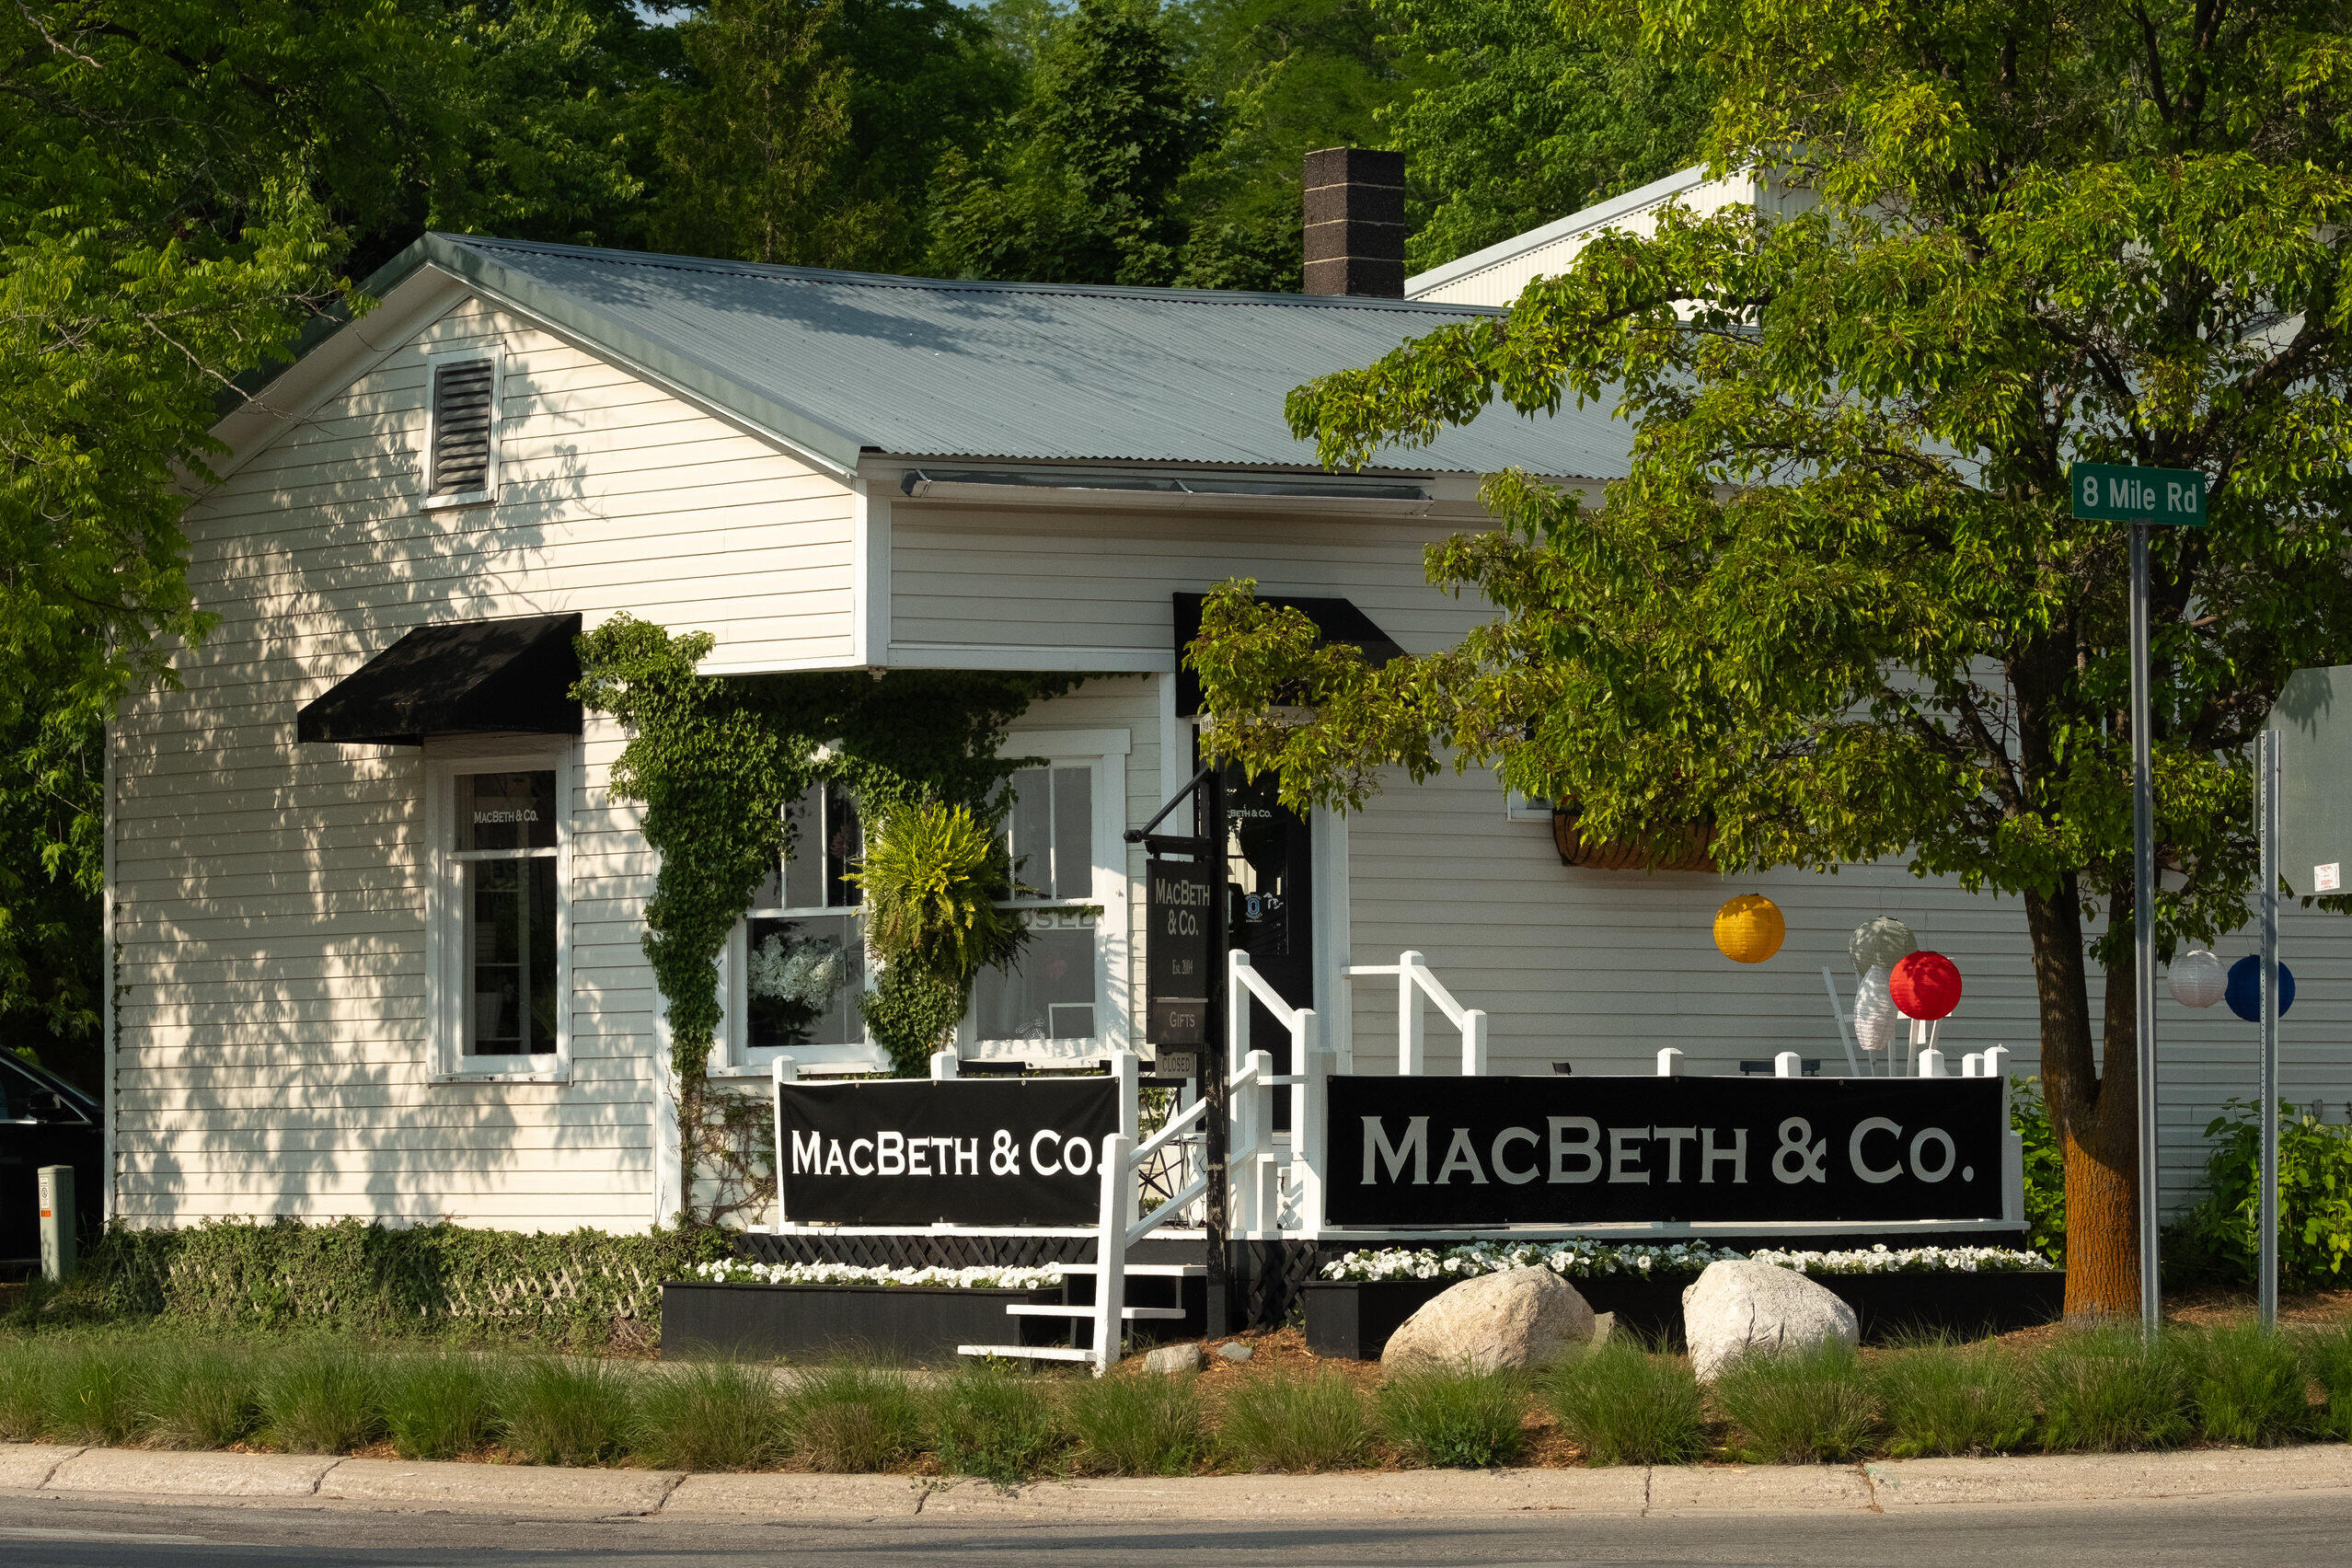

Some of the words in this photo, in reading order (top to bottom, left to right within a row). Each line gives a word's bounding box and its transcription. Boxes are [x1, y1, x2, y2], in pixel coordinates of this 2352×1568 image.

[2082, 476, 2099, 507] 8
[2109, 478, 2156, 511] Mile
[2167, 481, 2197, 513] Rd
[515, 809, 523, 822] &
[1251, 809, 1258, 817] &
[1168, 908, 1177, 936] &
[1161, 1056, 1191, 1073] CLOSED
[989, 1129, 1020, 1176] &
[1771, 1116, 1827, 1183] &
